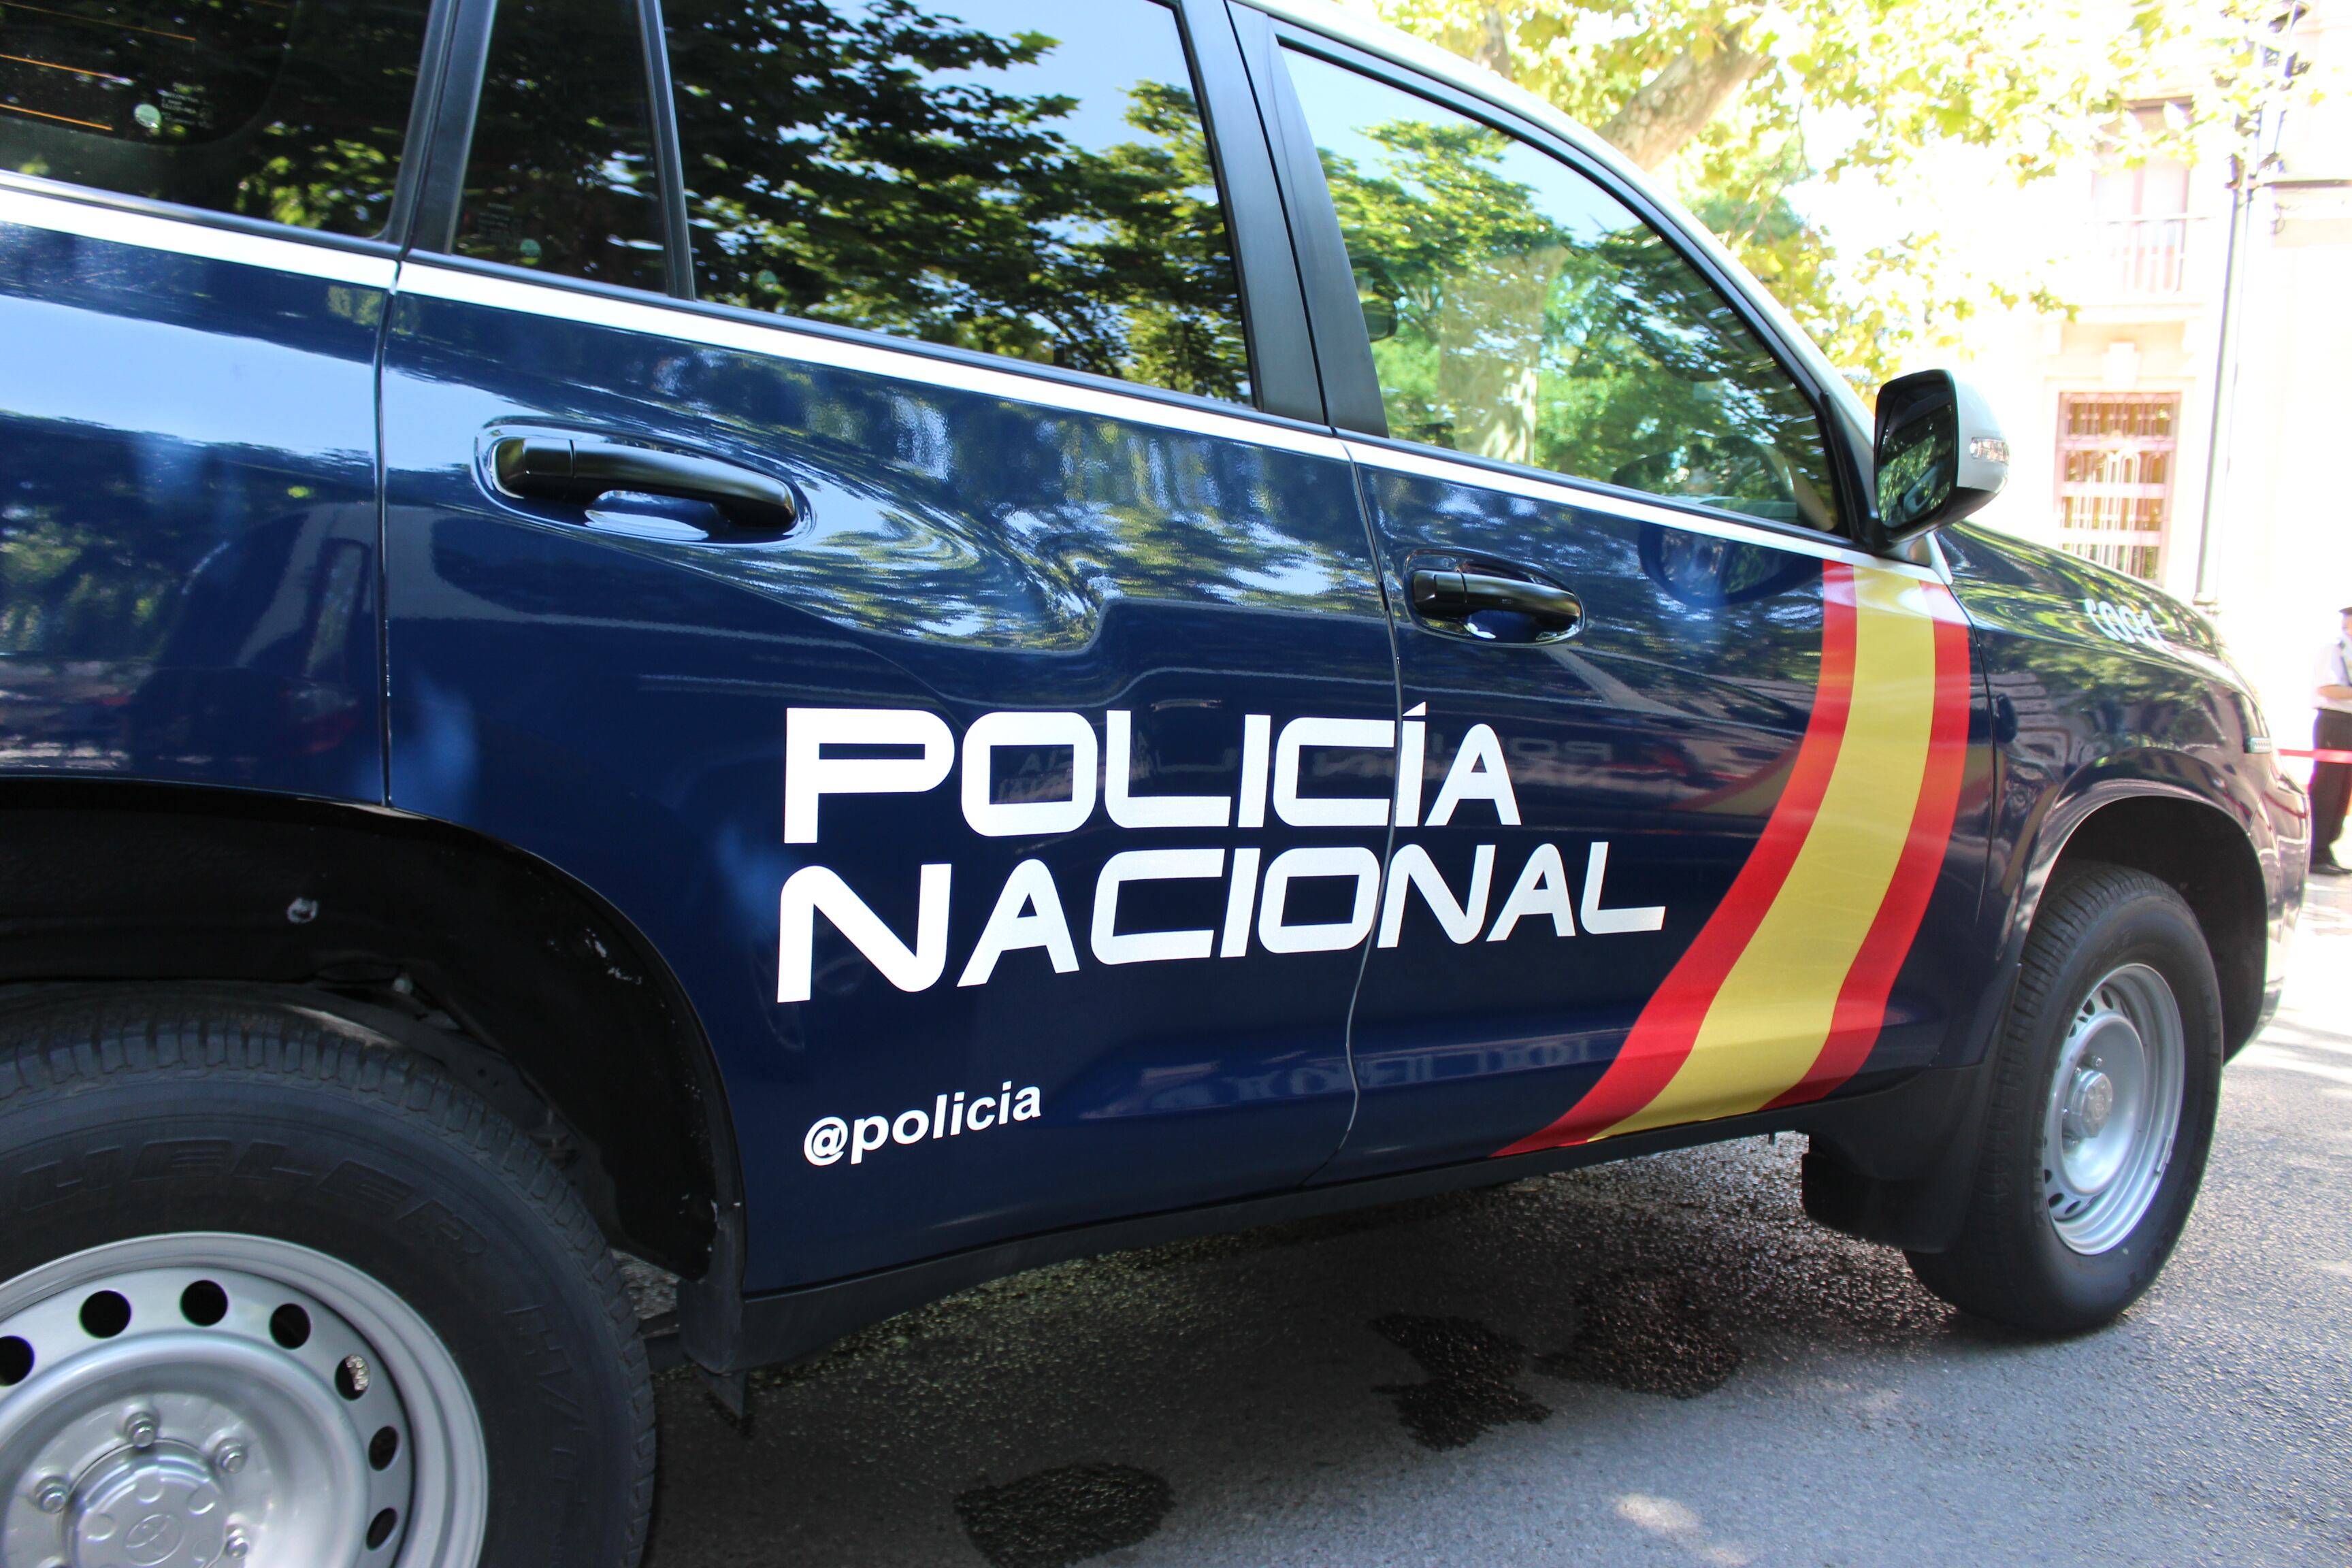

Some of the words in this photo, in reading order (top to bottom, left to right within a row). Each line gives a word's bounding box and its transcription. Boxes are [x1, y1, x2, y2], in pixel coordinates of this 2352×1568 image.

[784, 702, 1522, 844] POLICÍA
[777, 842, 1666, 1003] NACIONAL
[804, 1081, 1042, 1166] @policia
